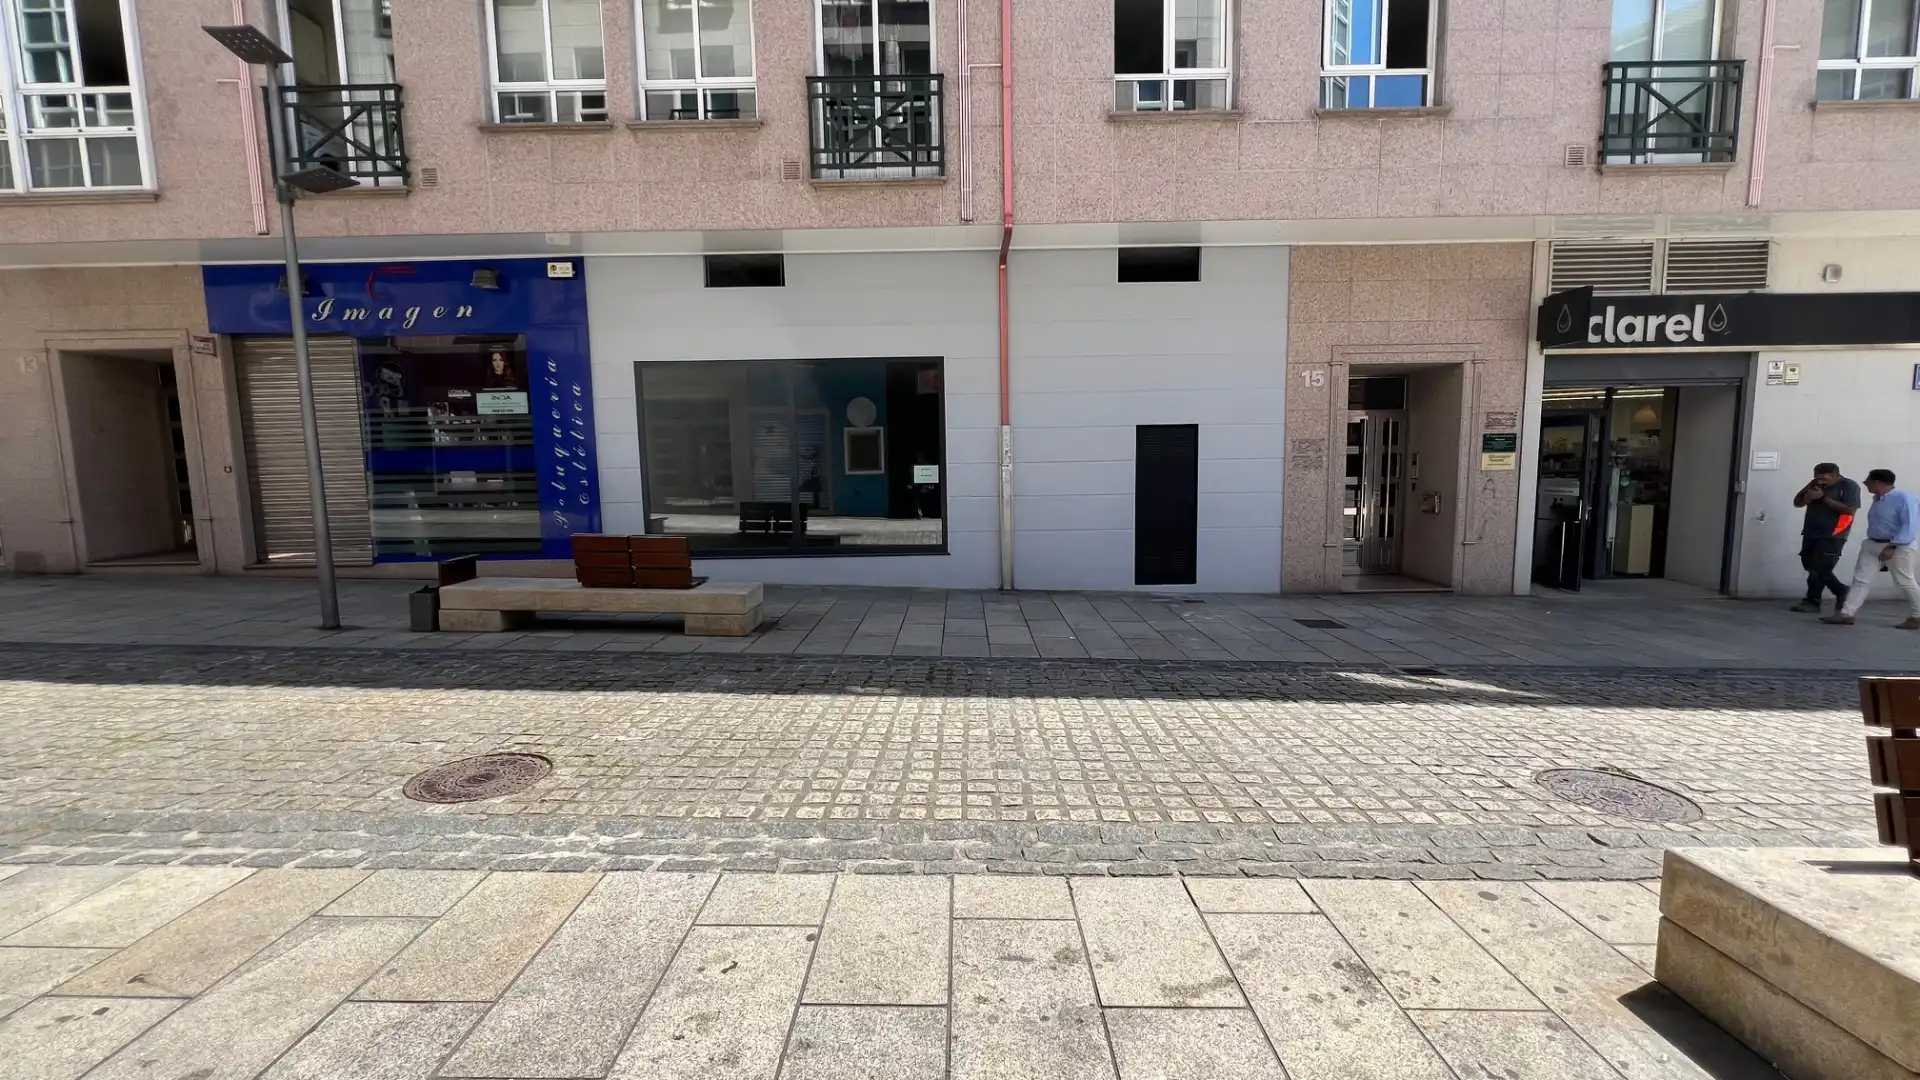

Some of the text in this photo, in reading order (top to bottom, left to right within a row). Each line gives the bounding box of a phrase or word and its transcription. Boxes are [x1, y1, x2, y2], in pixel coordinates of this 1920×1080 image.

[311, 298, 473, 329] Imagen
[1587, 303, 1706, 343] clarel
[1301, 370, 1325, 387] 15
